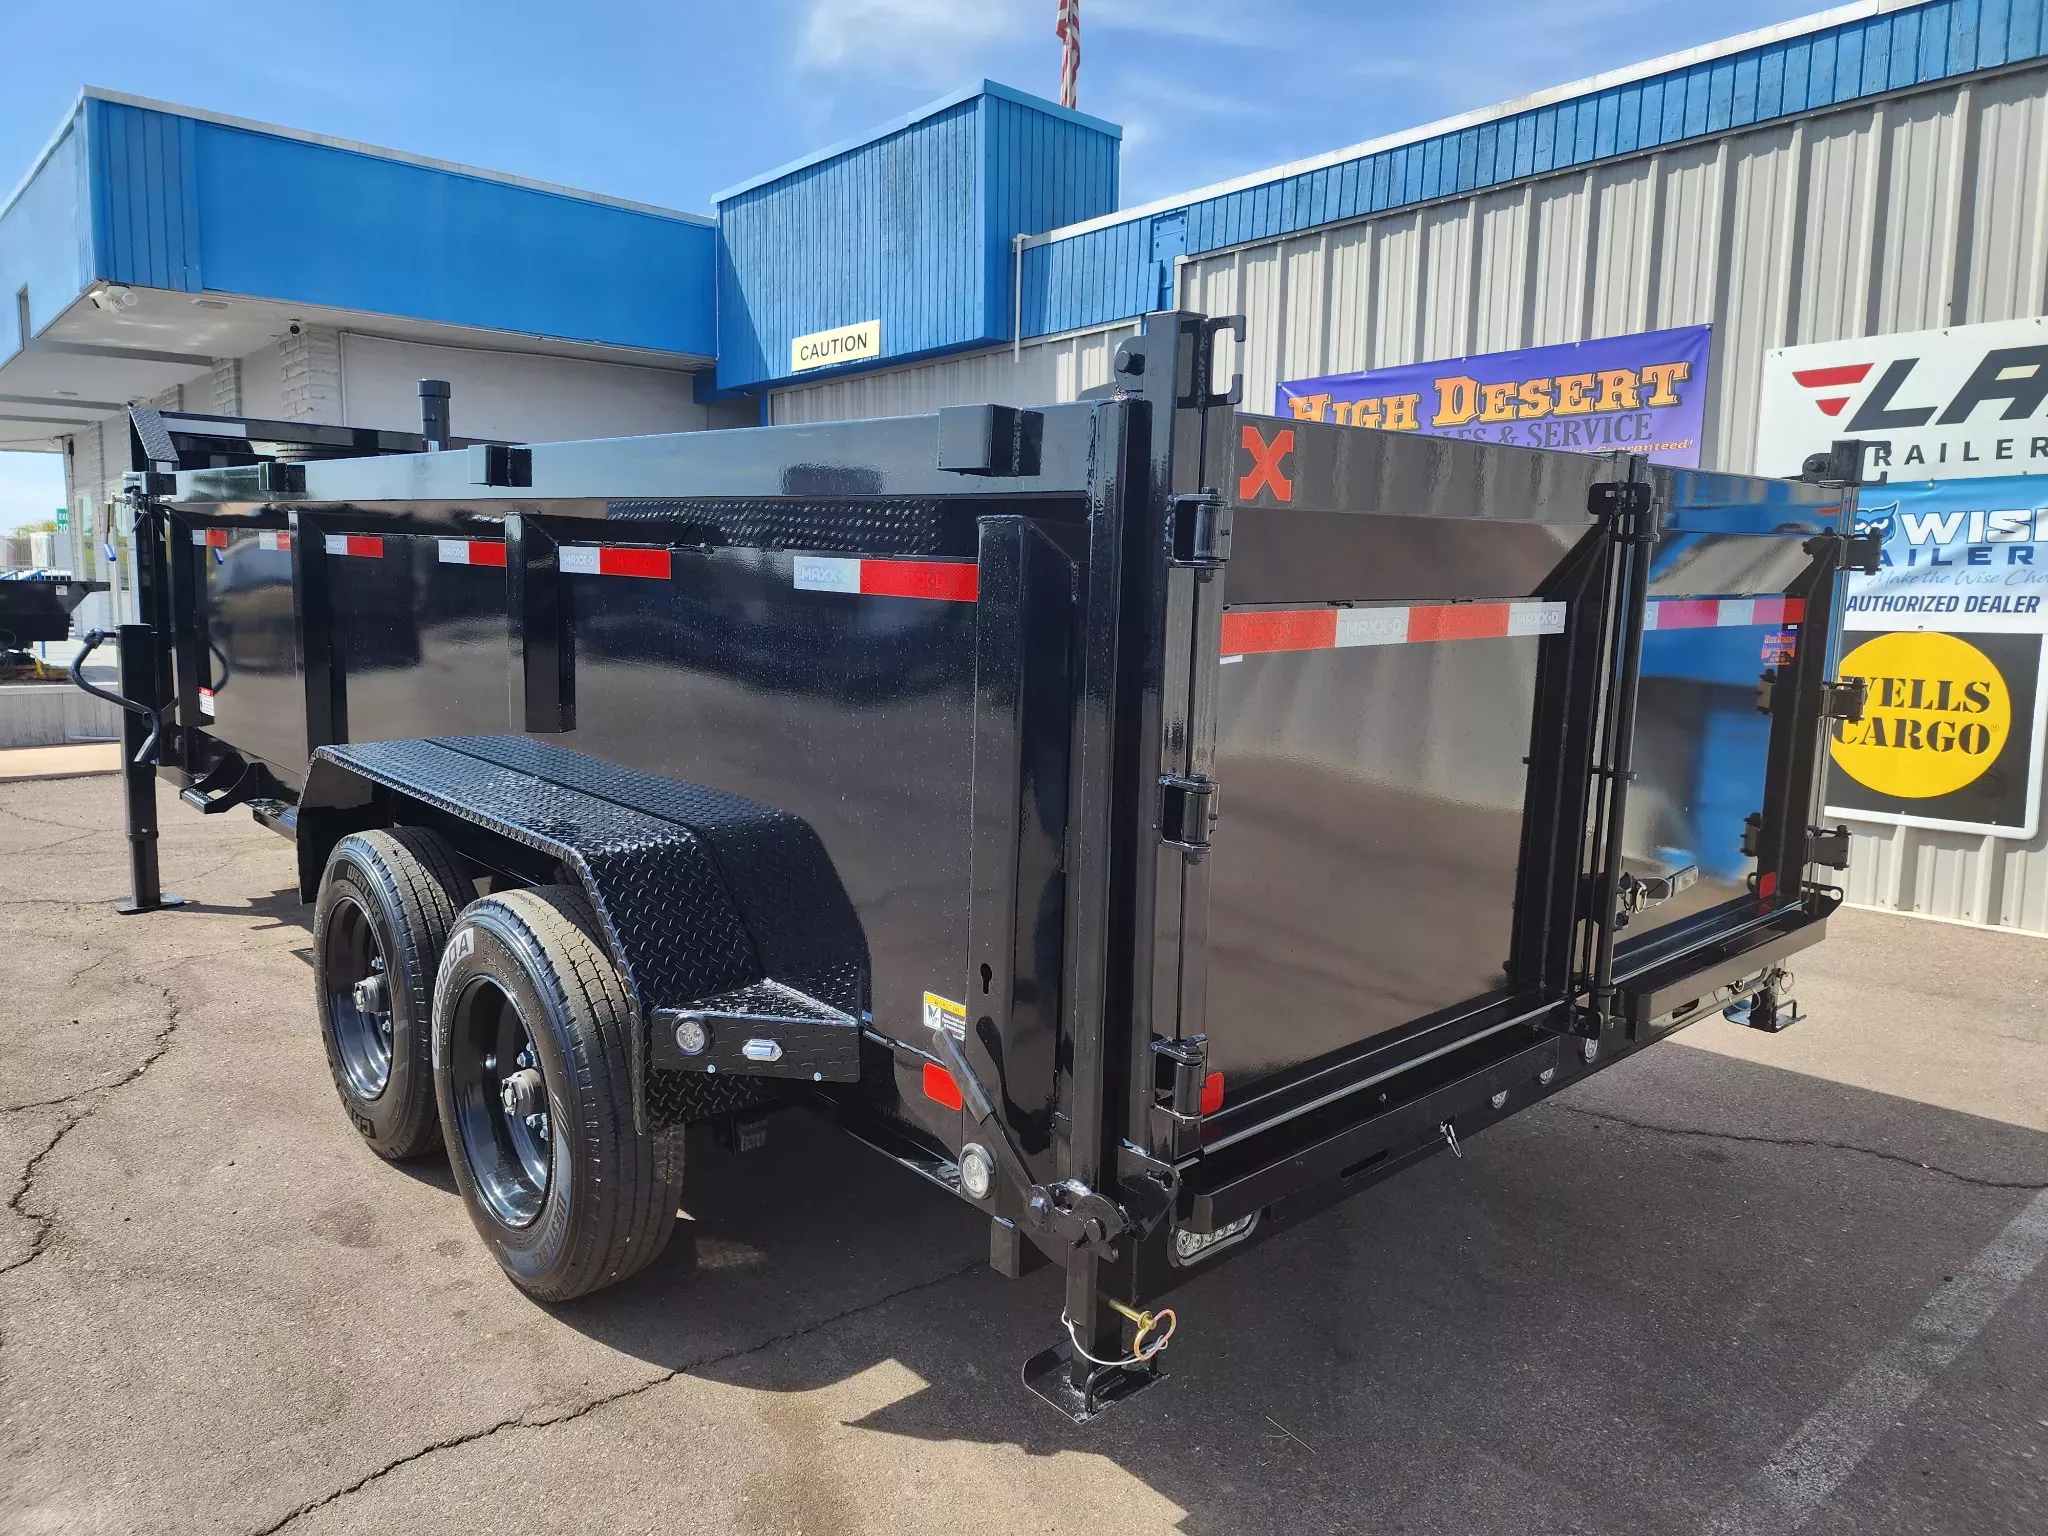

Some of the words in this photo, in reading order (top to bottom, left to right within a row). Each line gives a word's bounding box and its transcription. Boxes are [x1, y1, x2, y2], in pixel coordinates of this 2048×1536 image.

[800, 332, 867, 361] CAUTION
[1288, 391, 1422, 431] HIGH
[1431, 360, 1693, 428] DESERT
[1843, 345, 2048, 432] LA
[1527, 412, 1653, 447] SERVICE
[1873, 437, 2048, 467] RAILER
[1867, 570, 1918, 588] Make
[1921, 569, 1949, 585] the
[1955, 570, 2000, 585] Wise
[2005, 568, 2048, 586] Cho
[1846, 595, 1960, 613] AUTHORIZED
[1964, 595, 2041, 614] DEALER
[1840, 675, 1991, 714] ELLS
[1832, 716, 1991, 756] CARGO
